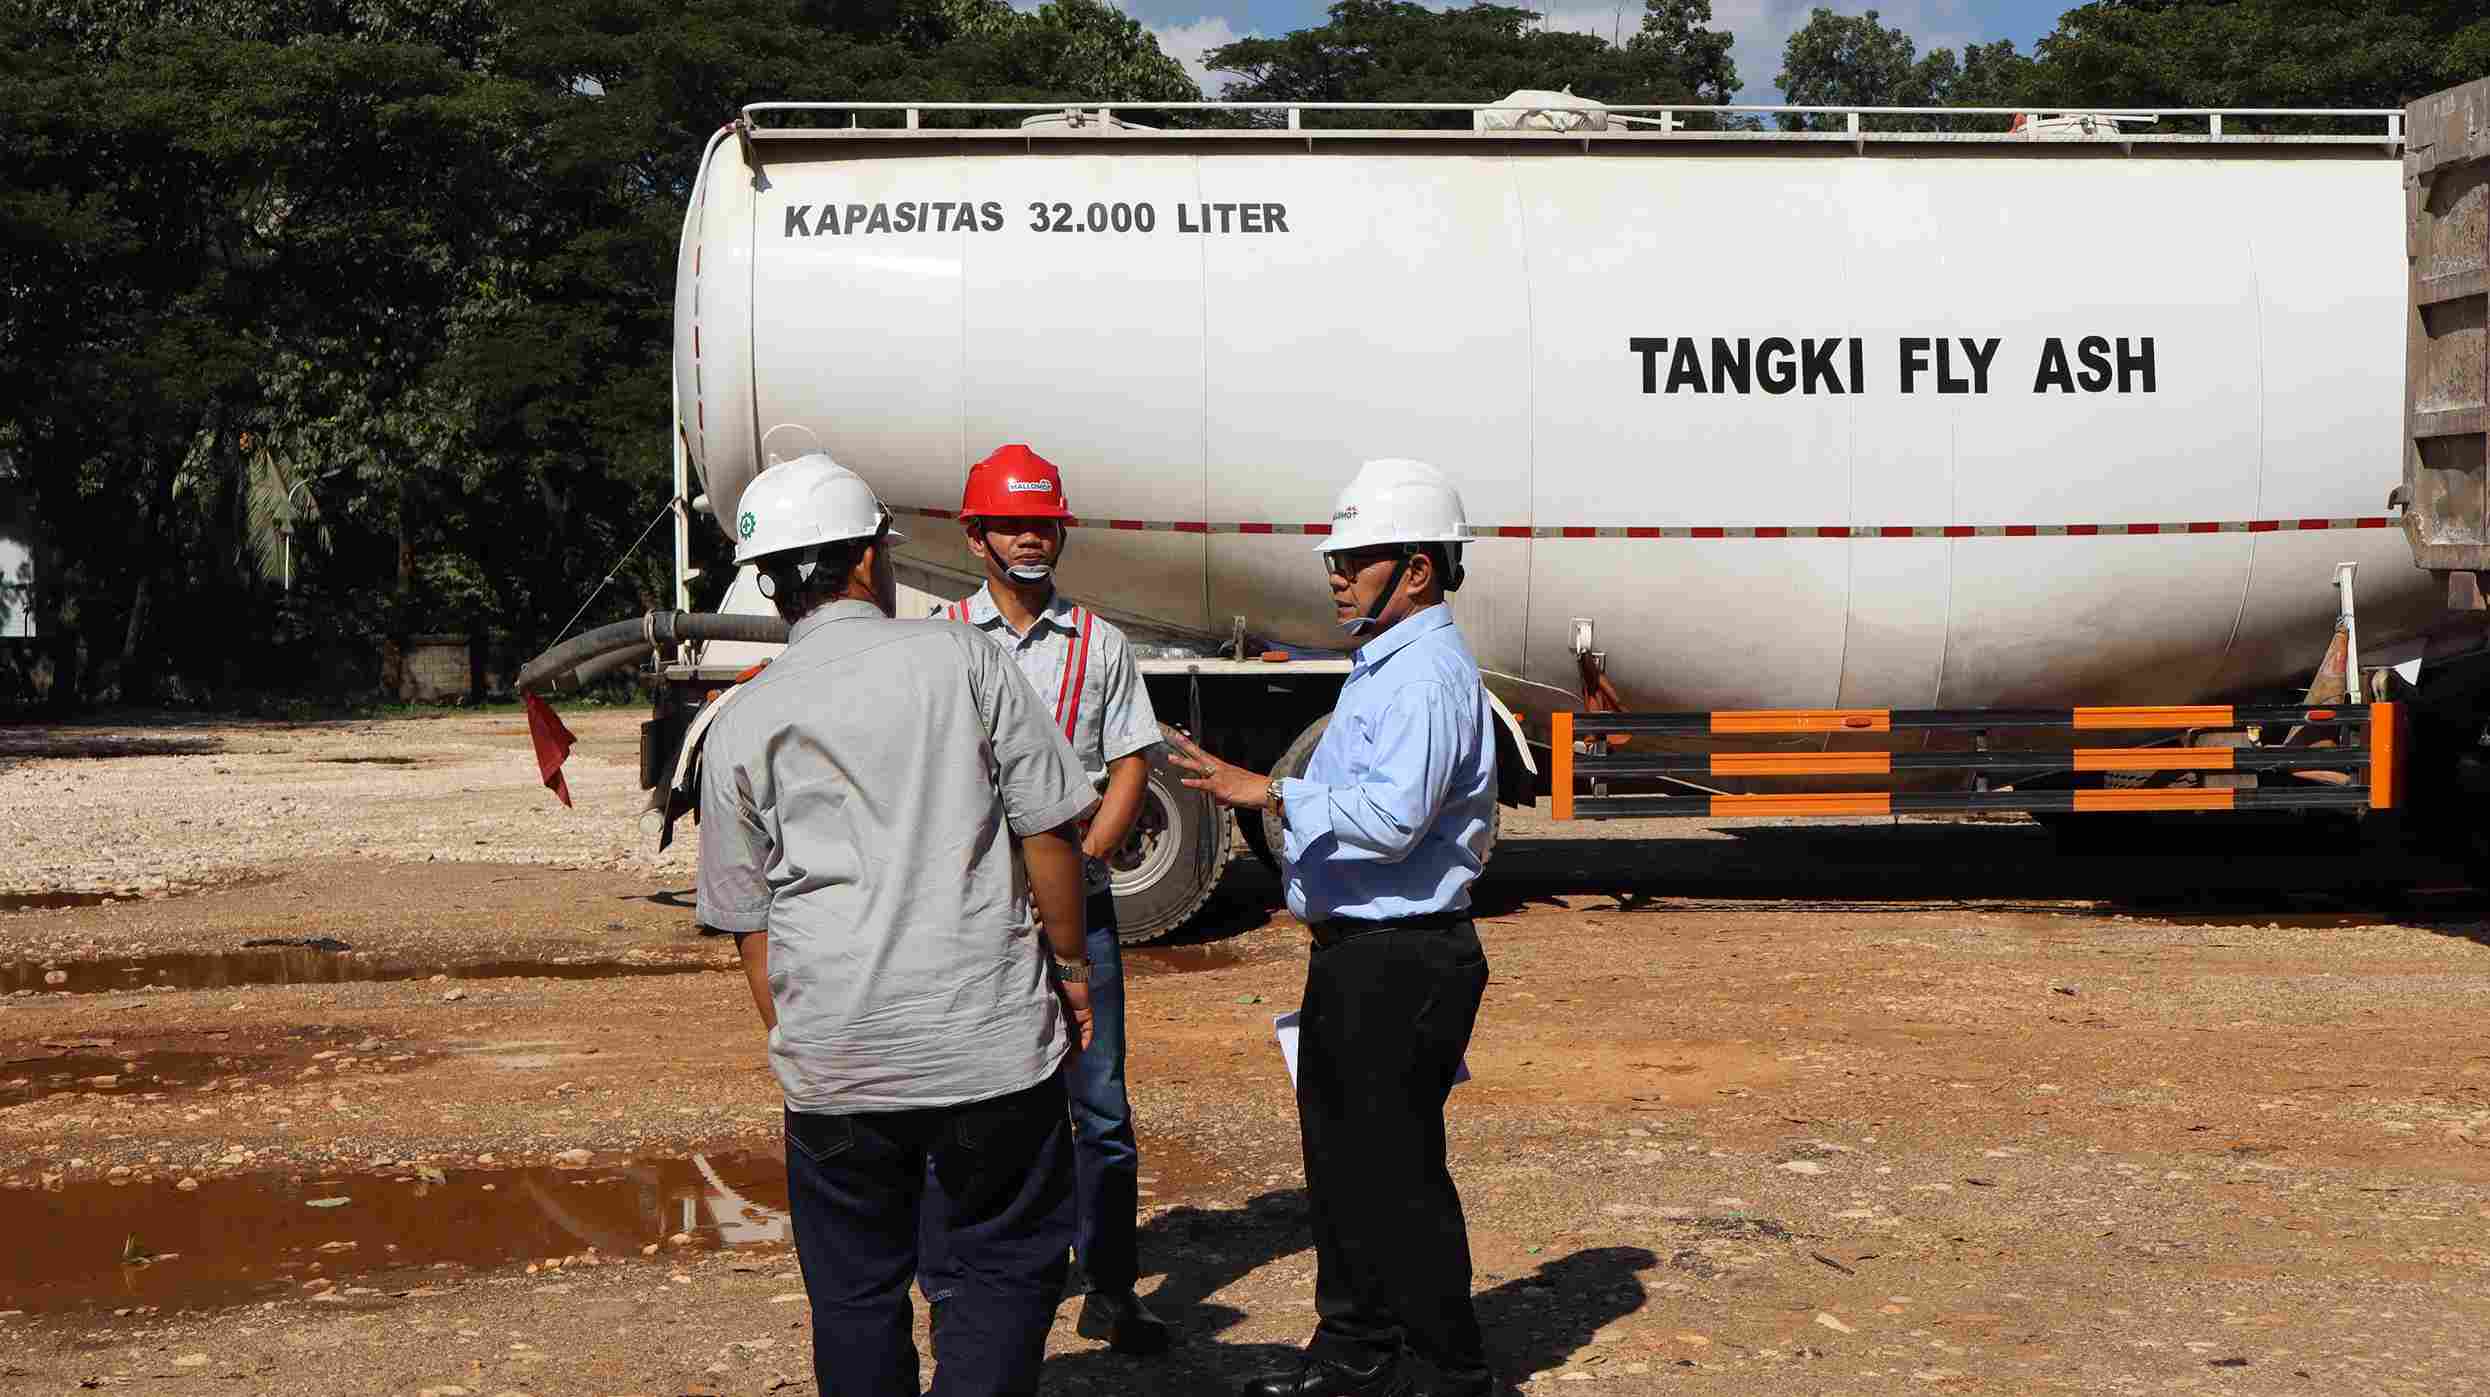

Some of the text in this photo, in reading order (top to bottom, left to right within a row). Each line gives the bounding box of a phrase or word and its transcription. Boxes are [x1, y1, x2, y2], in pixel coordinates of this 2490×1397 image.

[784, 201, 1290, 238] KAPASITAS 32.000 LITER
[1629, 335, 2157, 395] TANGKI FLY ASH
